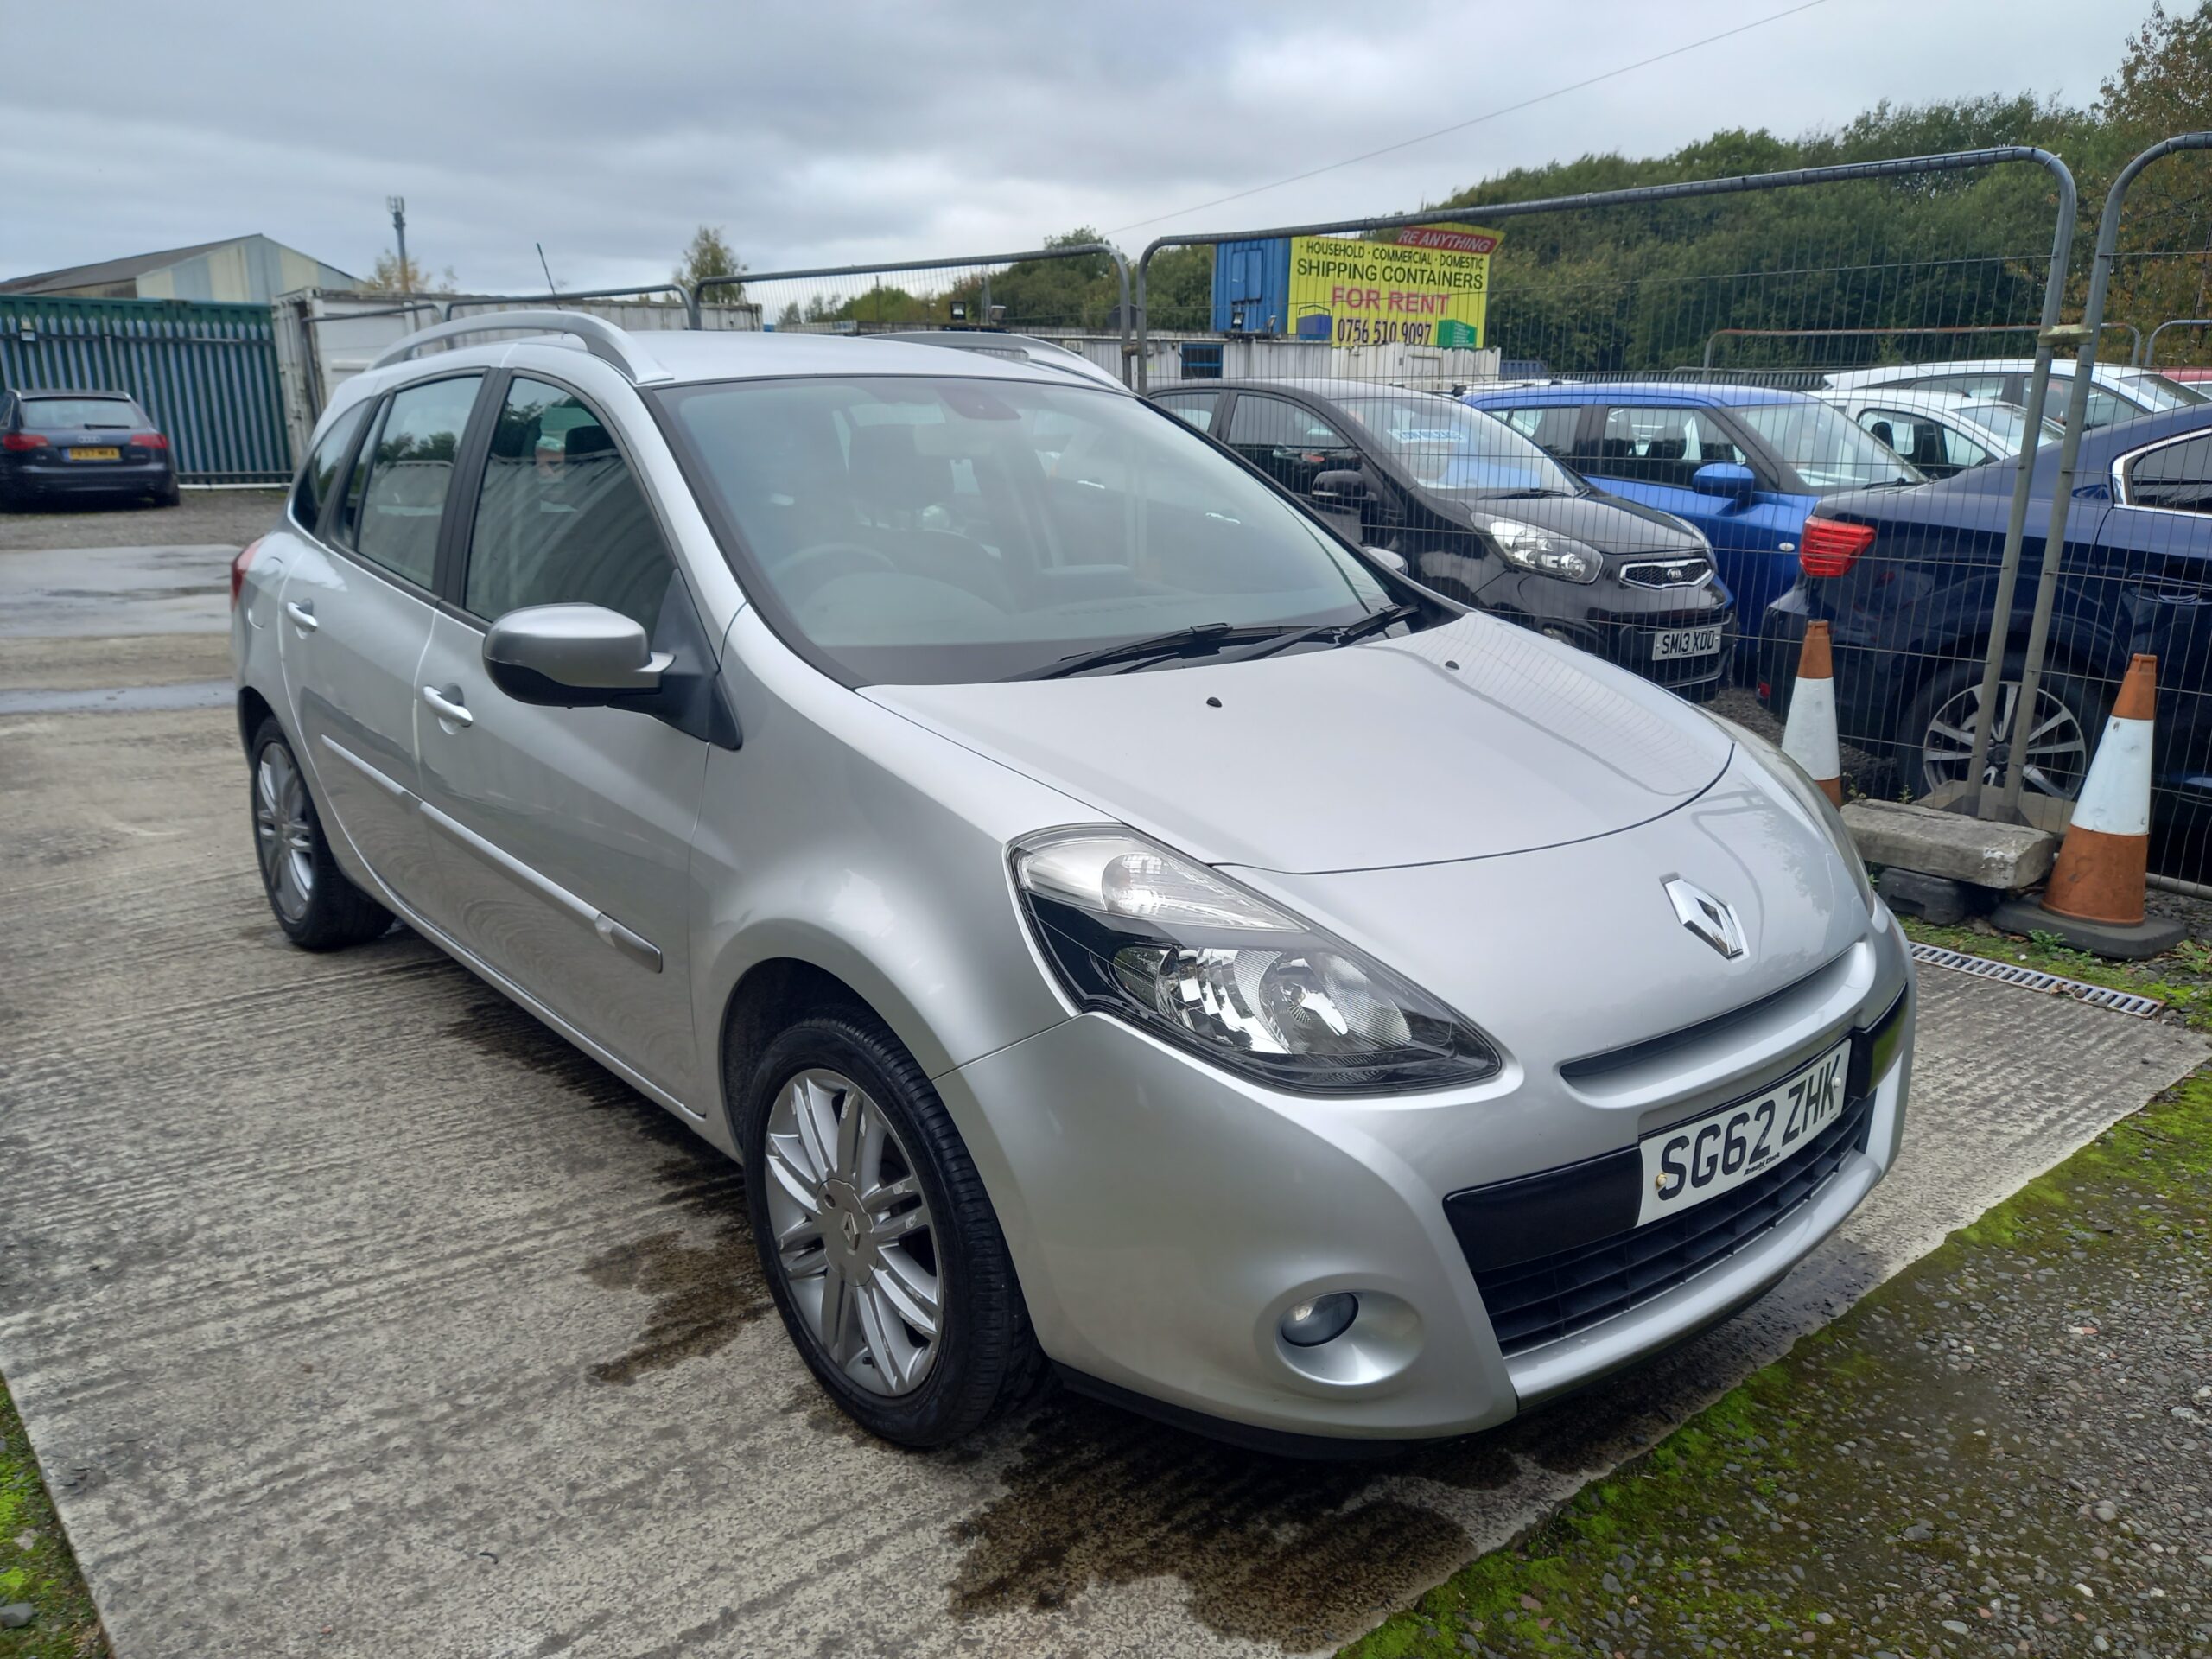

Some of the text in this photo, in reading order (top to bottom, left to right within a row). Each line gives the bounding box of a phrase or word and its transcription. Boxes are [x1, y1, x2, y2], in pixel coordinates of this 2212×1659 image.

[1306, 241, 1484, 270] HOUSEHOLD COMMERCIAL DOMESTIC
[1419, 232, 1491, 251] ANYTHING
[1297, 258, 1484, 290] SHIPPING CONTAINERS
[1332, 287, 1450, 315] FOR RENT
[1338, 318, 1370, 344] 0756
[1373, 321, 1397, 345] 510
[1402, 321, 1432, 346] 9097
[1662, 632, 1691, 655] SM13
[1657, 1053, 1840, 1201] SG62 ZHK
